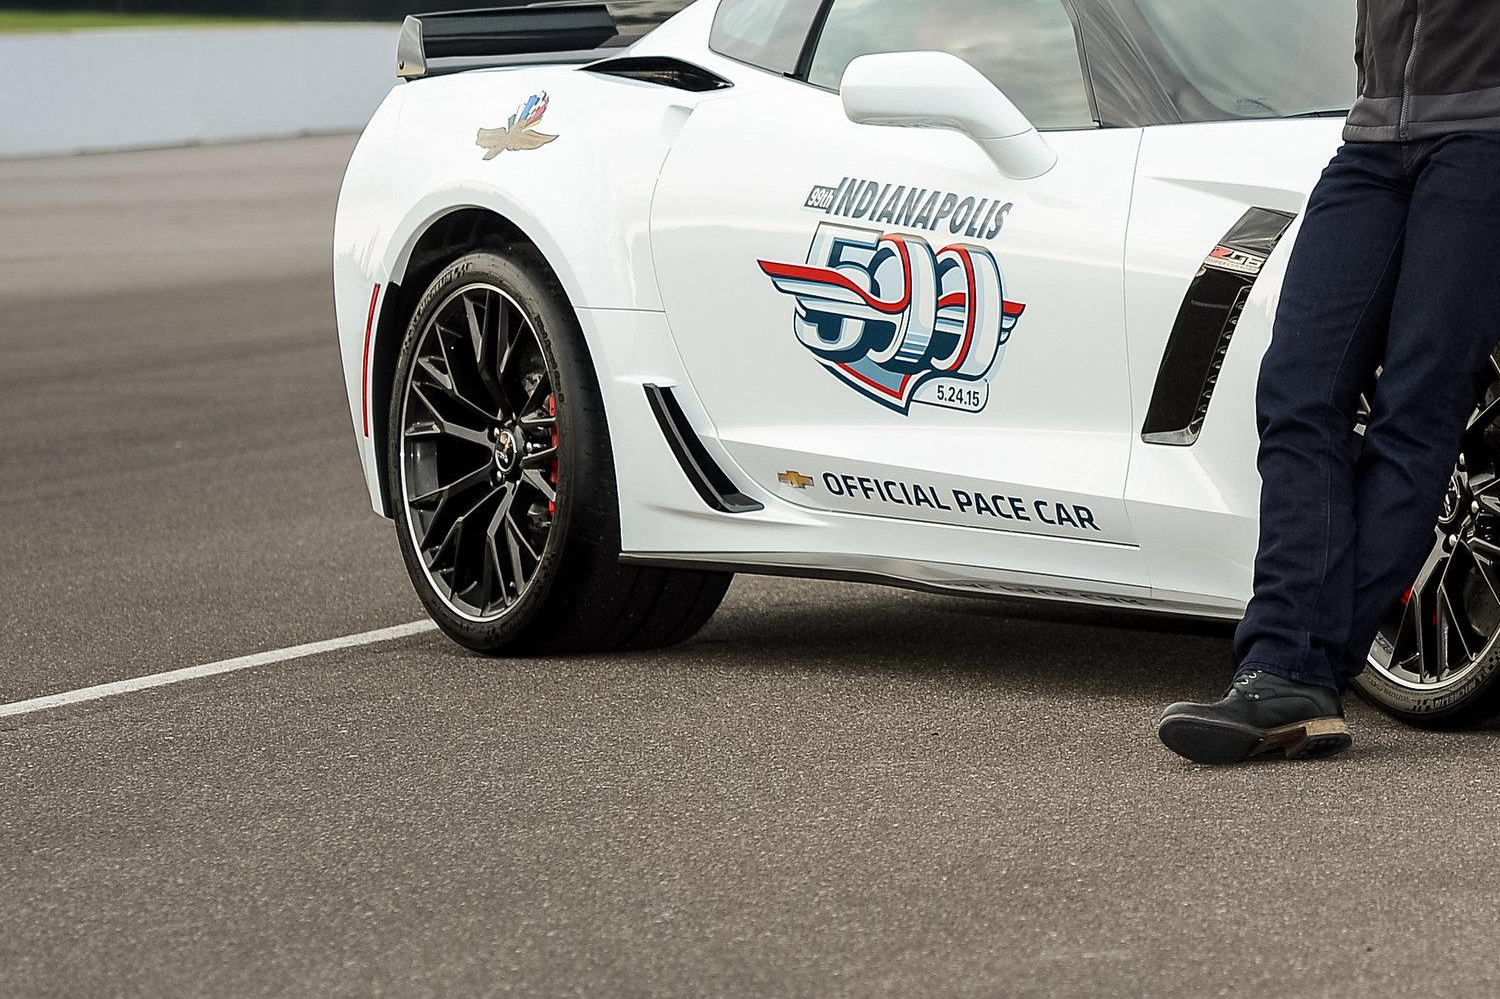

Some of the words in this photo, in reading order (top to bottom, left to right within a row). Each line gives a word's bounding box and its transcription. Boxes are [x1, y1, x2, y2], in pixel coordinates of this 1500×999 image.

[809, 187, 834, 208] 99th
[825, 177, 1013, 240] INDIANAPOLIS
[793, 221, 1004, 381] 500
[937, 385, 980, 407] 5.24.15
[821, 471, 952, 511] OFFICIAL
[952, 489, 1030, 521] PACE
[1034, 500, 1101, 531] CAR
